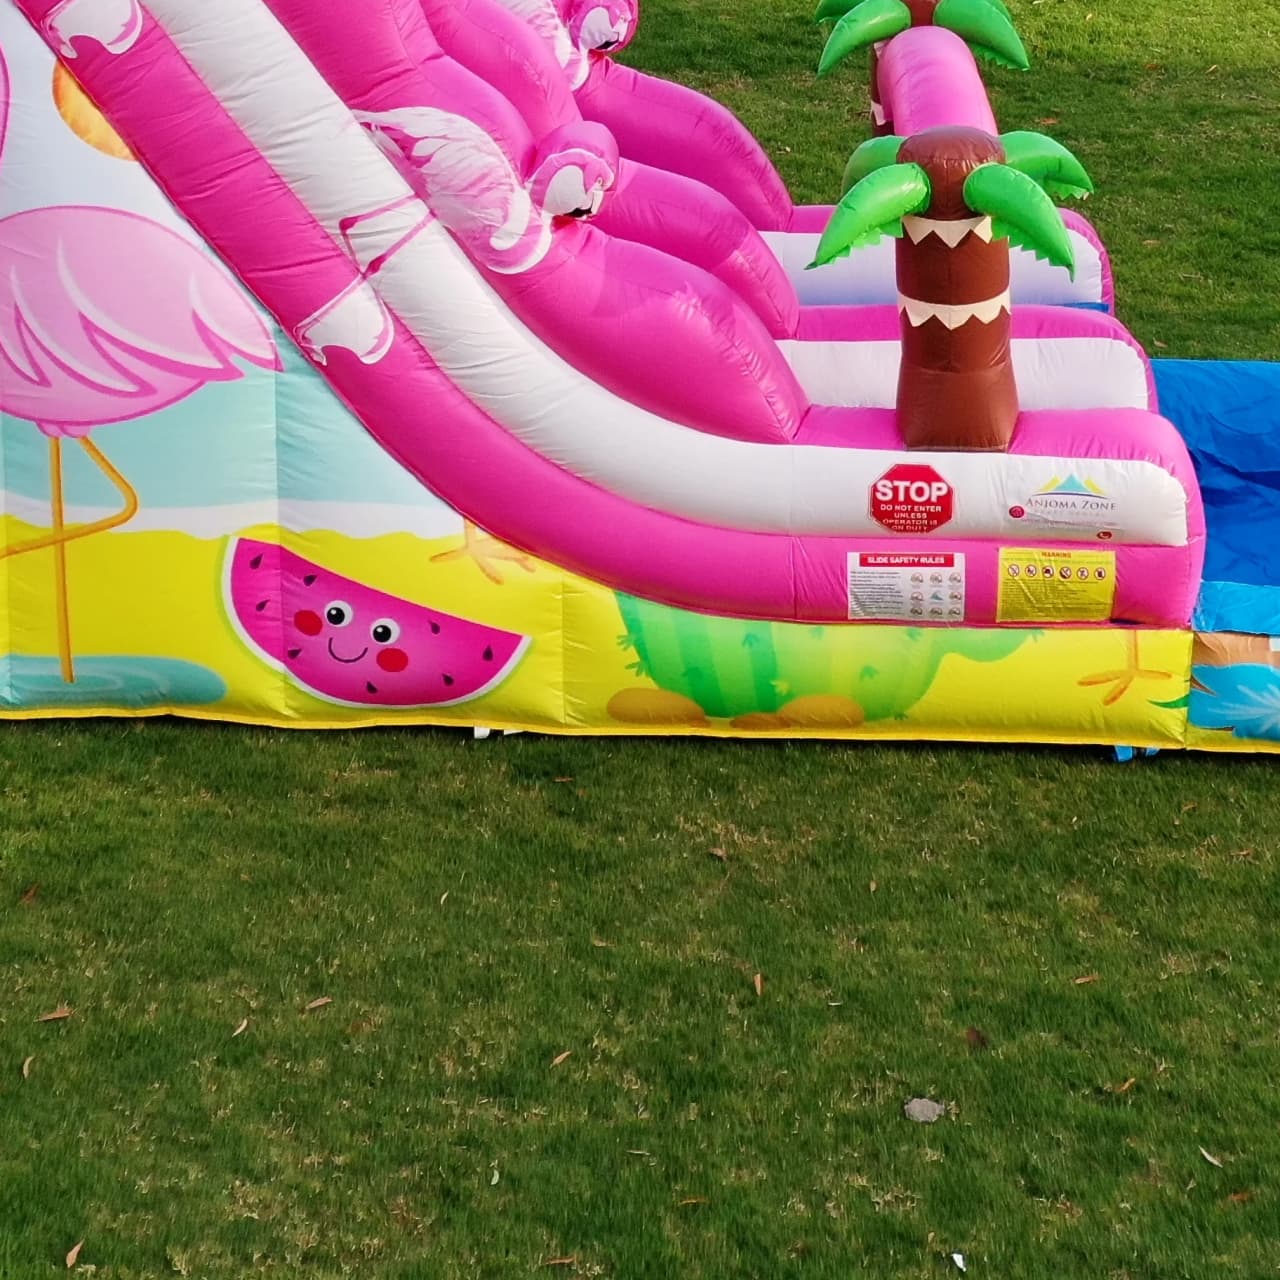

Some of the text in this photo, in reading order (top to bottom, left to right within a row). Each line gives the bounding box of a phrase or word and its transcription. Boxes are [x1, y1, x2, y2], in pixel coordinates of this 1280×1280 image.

[875, 479, 948, 503] STOP
[894, 504, 911, 512] NOT
[913, 505, 942, 513] ENTER
[1082, 500, 1117, 511] ZONE
[867, 556, 944, 564] SLIDE SAFETY RULES
